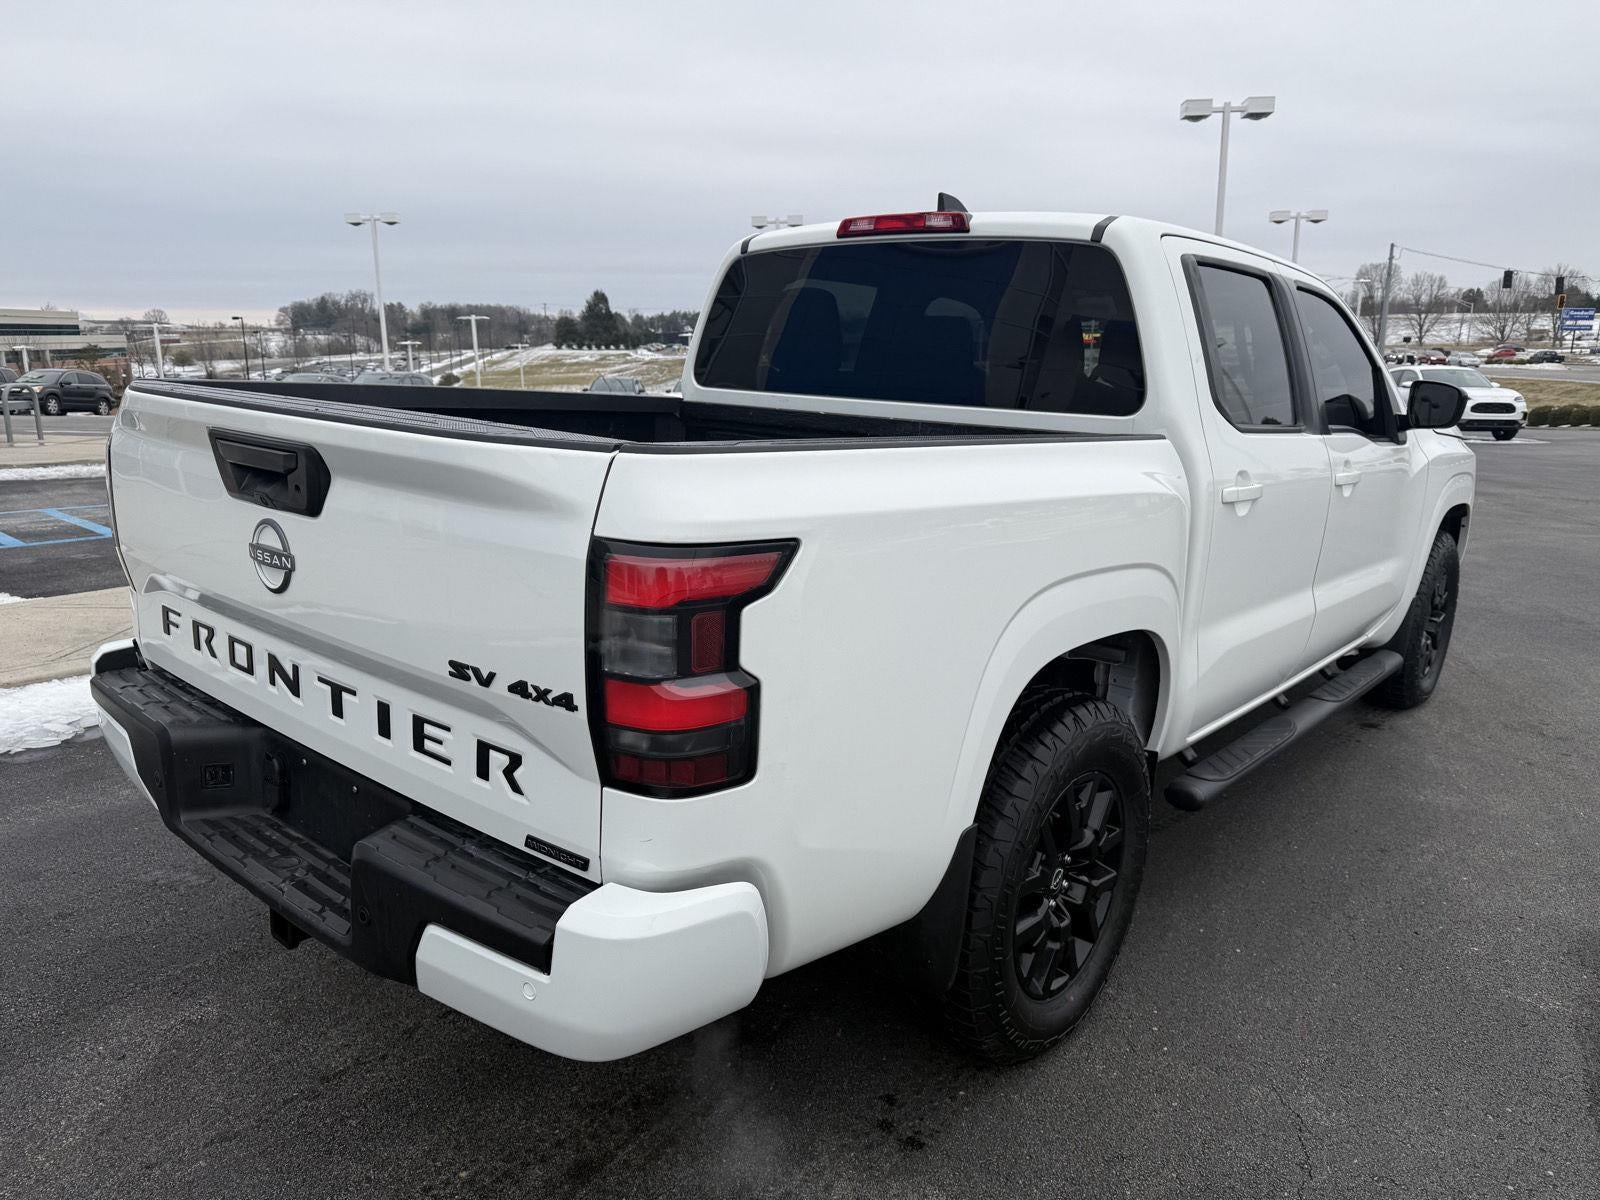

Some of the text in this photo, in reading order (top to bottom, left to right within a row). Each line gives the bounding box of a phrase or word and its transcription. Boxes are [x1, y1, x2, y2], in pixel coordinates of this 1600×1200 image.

[448, 659, 497, 688] SV
[161, 604, 524, 796] FRONTIER
[526, 838, 586, 868] MIDNIGHT
